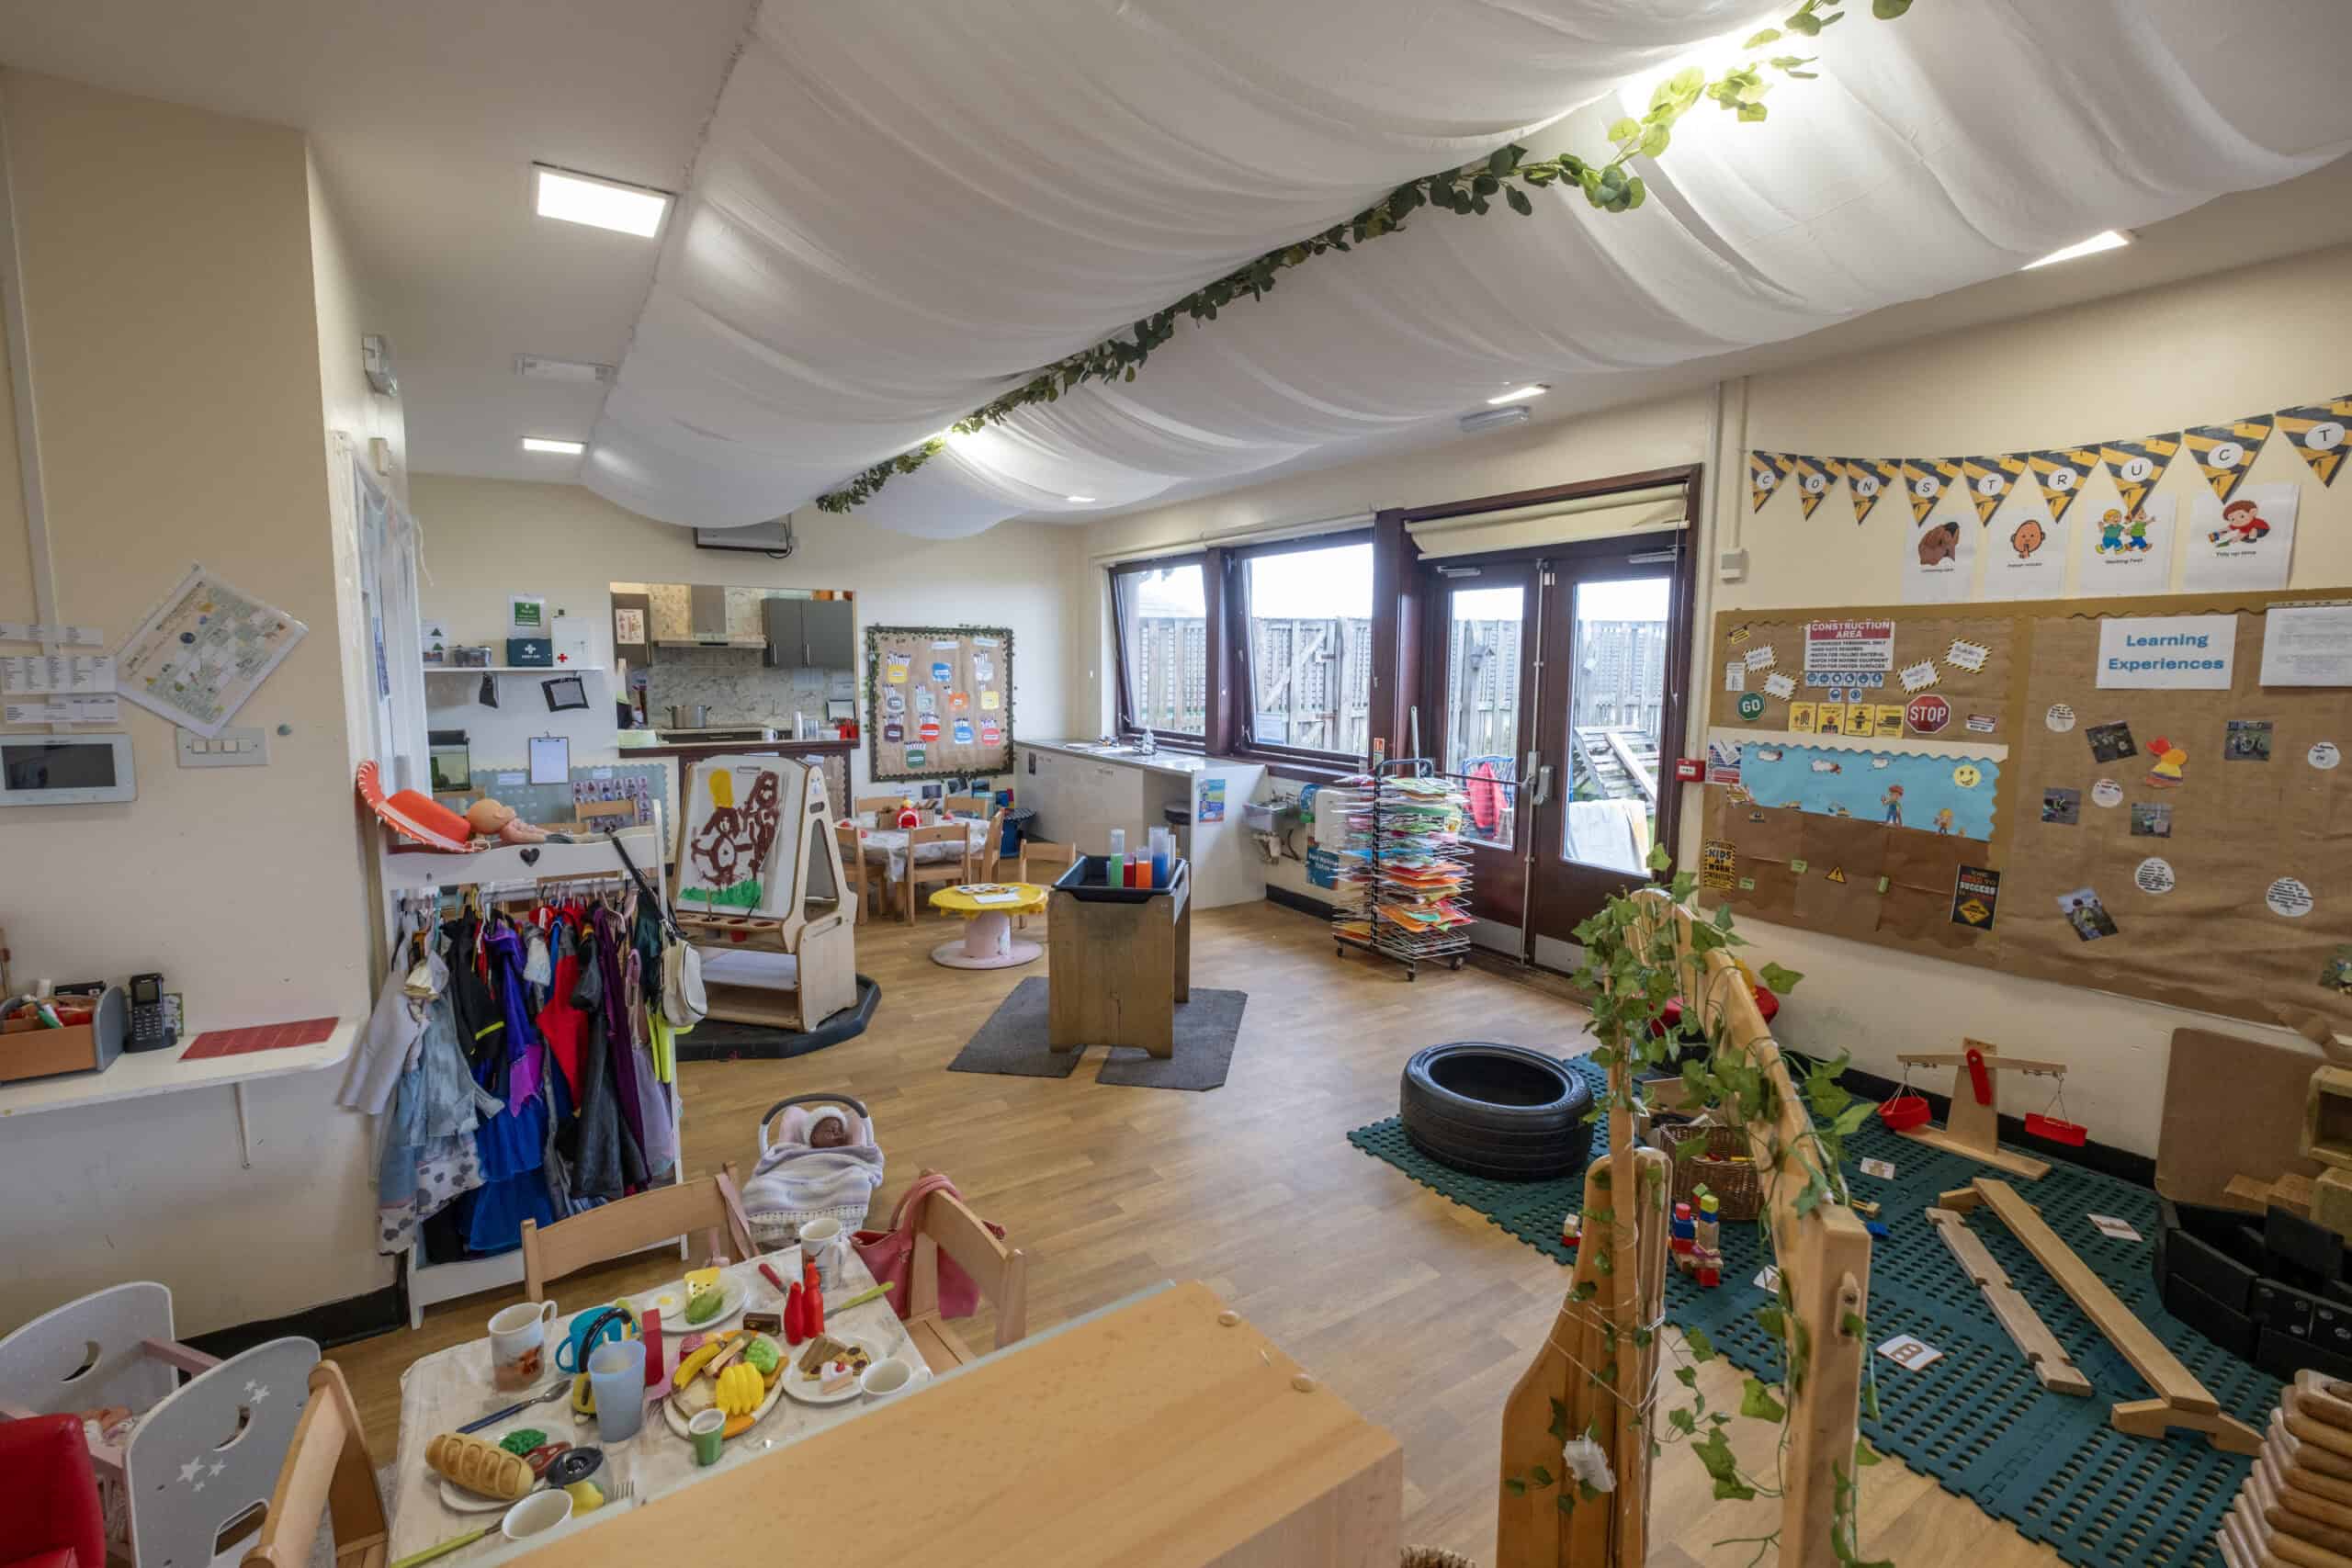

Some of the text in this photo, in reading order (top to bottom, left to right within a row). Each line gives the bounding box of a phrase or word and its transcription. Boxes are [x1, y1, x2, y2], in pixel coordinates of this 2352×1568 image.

[1862, 481, 1872, 492] N
[1921, 482, 1931, 492] S
[1987, 479, 1996, 490] T
[2057, 474, 2067, 485] R
[2131, 464, 2143, 476] U
[2218, 448, 2230, 461] C
[2318, 428, 2331, 442] T
[1811, 621, 1890, 632] CONSTRUCTION
[1836, 630, 1862, 639] AREA
[2126, 634, 2210, 649] Learning
[2109, 658, 2224, 672] Experiences
[1742, 698, 1760, 713] GO
[1910, 705, 1947, 723] STOP
[1709, 848, 1732, 861] KIDS
[1959, 881, 1996, 895] SUCCESS
